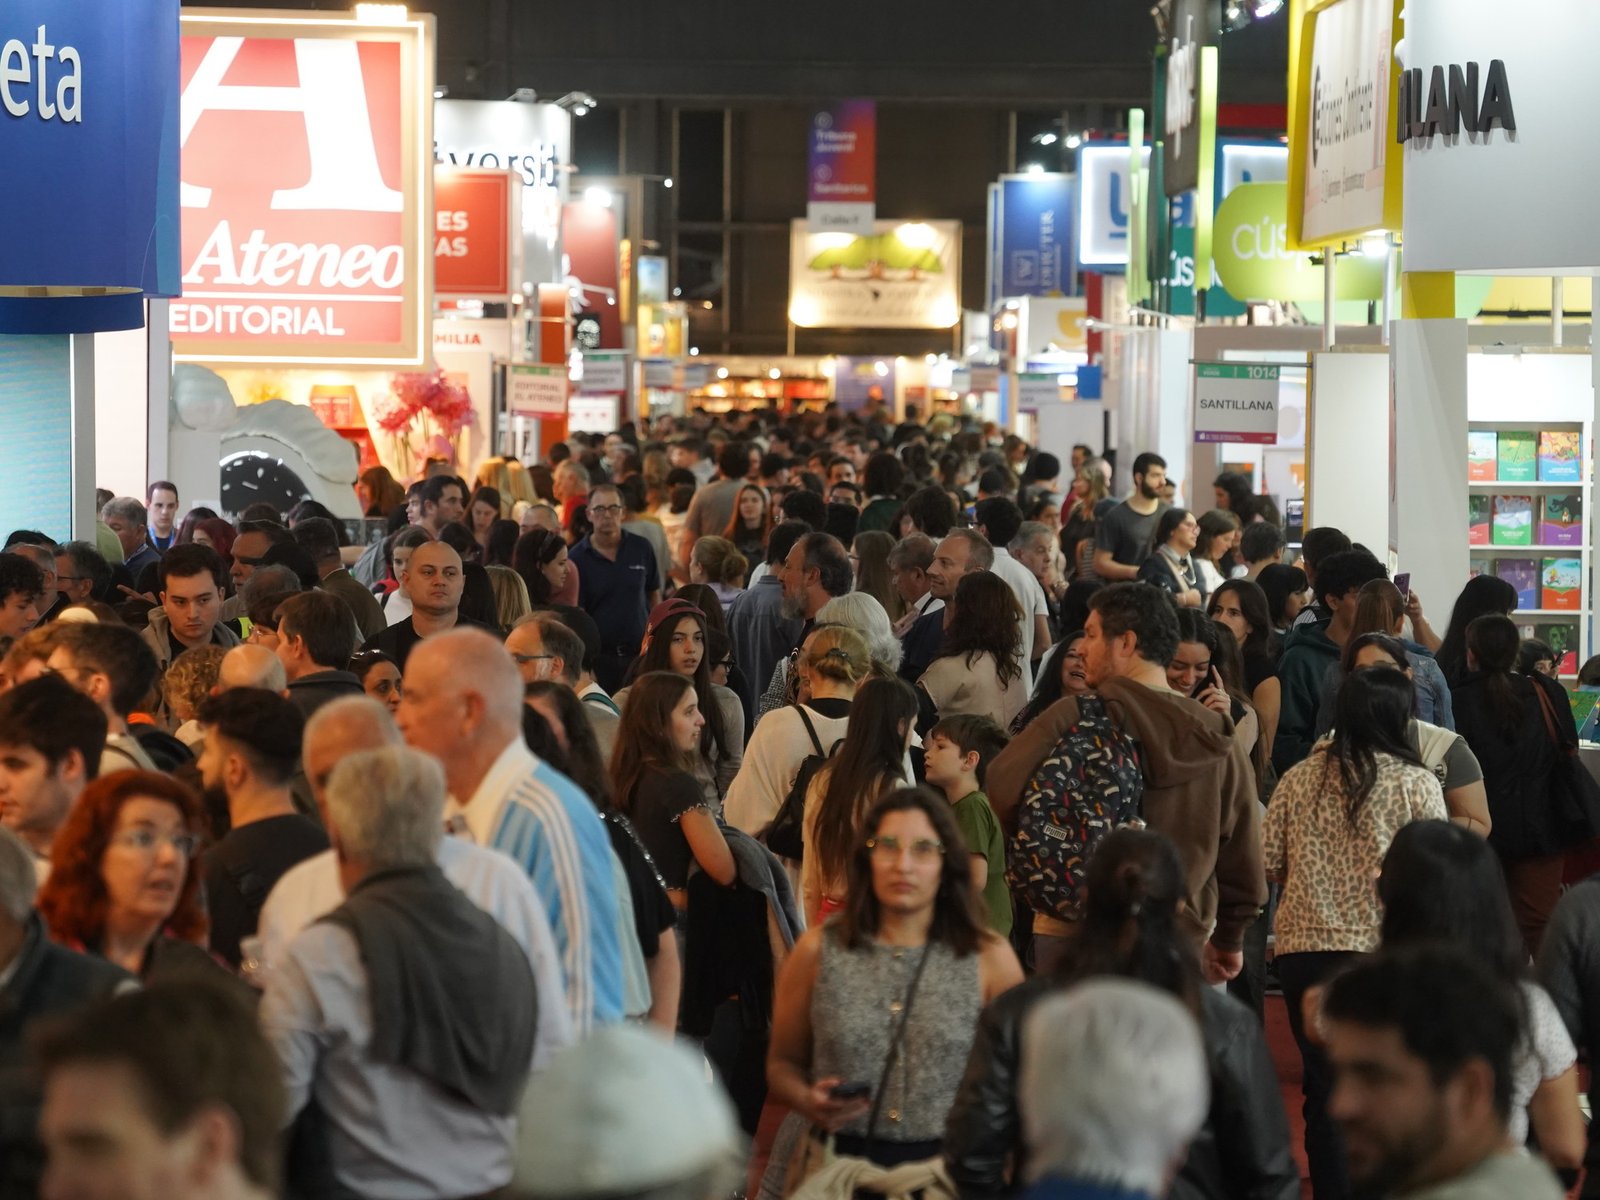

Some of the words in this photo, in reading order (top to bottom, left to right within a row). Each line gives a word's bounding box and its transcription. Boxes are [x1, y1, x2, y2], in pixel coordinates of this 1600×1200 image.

[0, 24, 82, 123] eta
[436, 211, 469, 231] ES
[182, 219, 405, 289] Ateneo
[168, 303, 345, 336] EDITORIAL
[1248, 366, 1278, 378] 1014
[1200, 399, 1274, 410] SANTILLANA
[1045, 827, 1066, 839] PUMA
